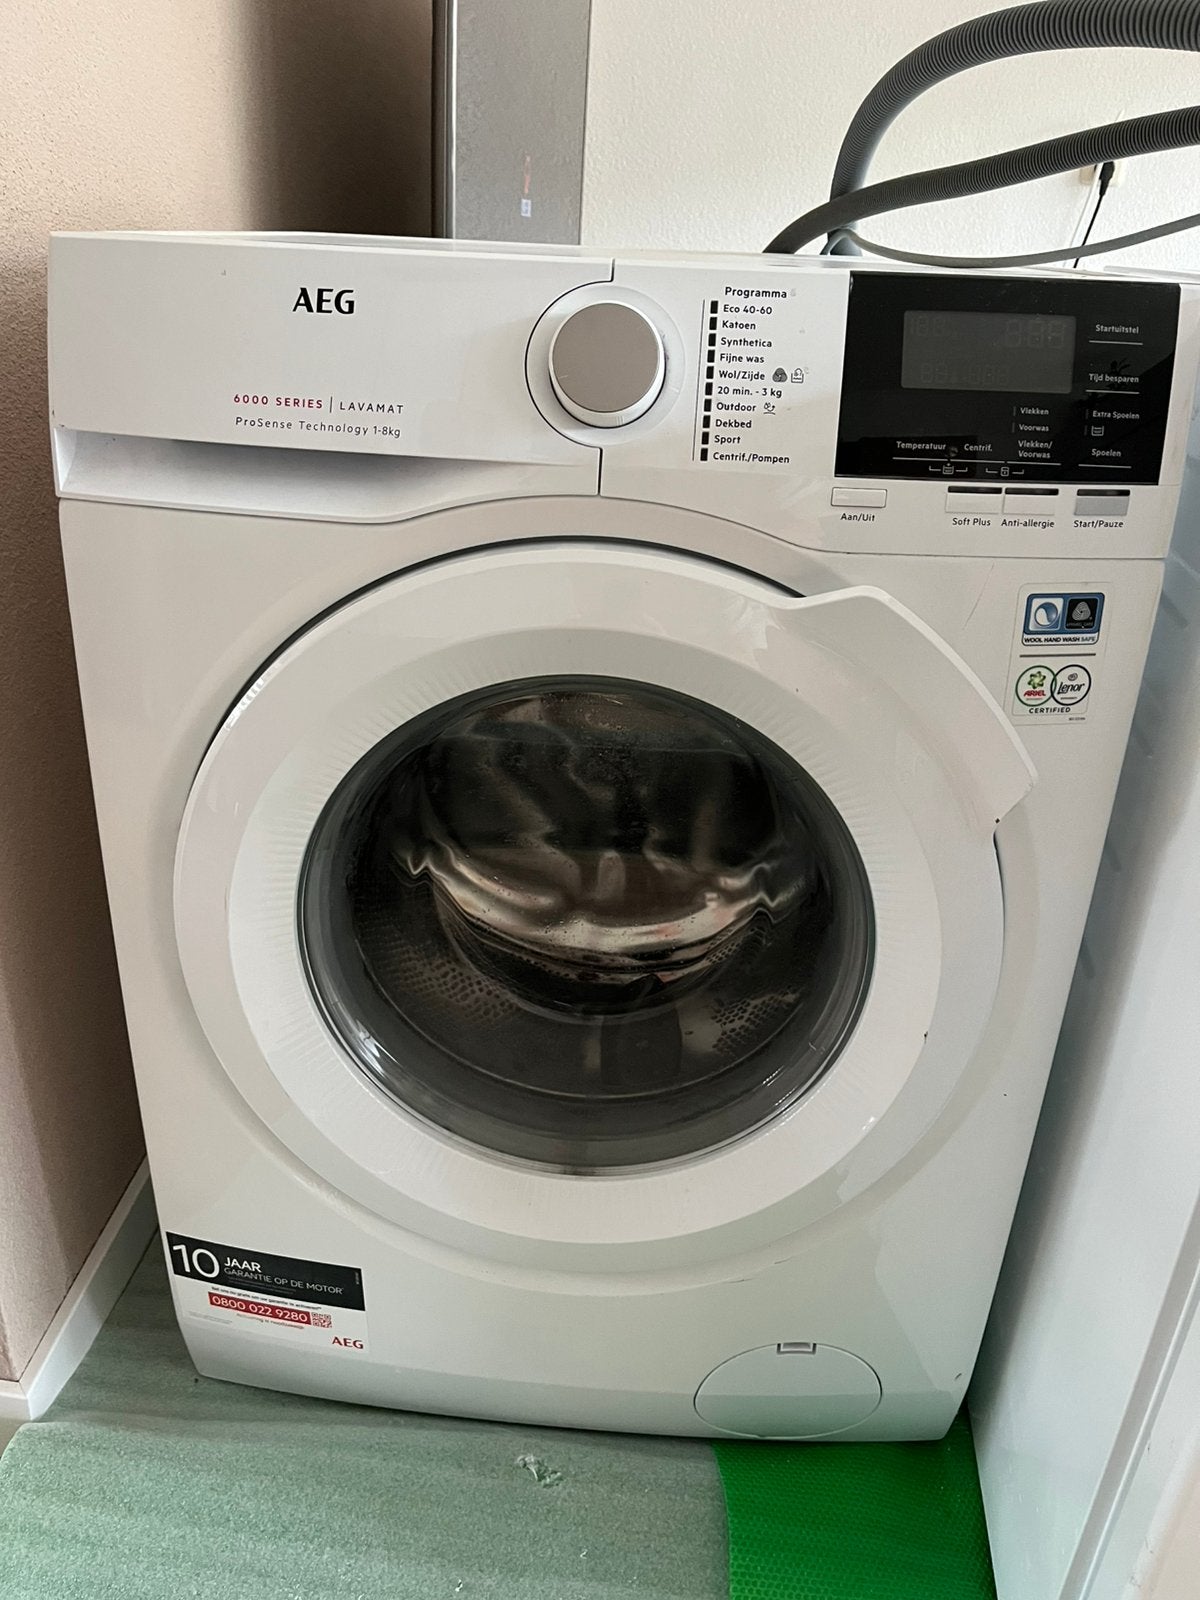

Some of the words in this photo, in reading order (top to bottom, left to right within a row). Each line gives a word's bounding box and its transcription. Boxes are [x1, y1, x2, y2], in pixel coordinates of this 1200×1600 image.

[725, 287, 787, 299] Programma
[293, 288, 355, 314] AEG
[723, 305, 740, 313] Eco
[743, 305, 772, 314] 40-60
[722, 321, 756, 330] Katoen
[1095, 324, 1139, 335] Startuitstel
[721, 337, 772, 348] Synthetica
[720, 354, 743, 363] Fijne
[719, 370, 765, 381] Wol/Zijde
[1089, 373, 1103, 383] Tijd
[1105, 374, 1139, 384] besparen
[717, 386, 730, 395] 20
[732, 387, 752, 396] min.
[762, 388, 768, 396] 3
[770, 388, 782, 398] kg
[233, 394, 268, 405] 6000
[276, 397, 323, 409] SERIES
[339, 401, 403, 414] LAVAMAT
[717, 402, 757, 412] Outdoor
[1020, 407, 1049, 415] Vlekken
[1093, 410, 1111, 419] Extra
[1112, 411, 1140, 420] Spoelen
[235, 417, 292, 428] ProSense
[299, 421, 368, 436] Technology
[373, 426, 401, 438] 1-8kg
[715, 419, 752, 428] Dekbed
[1019, 424, 1049, 432] Voorwas
[714, 435, 741, 445] Sport
[1018, 440, 1052, 450] Vlekken/
[896, 441, 946, 451] Temperatuur
[964, 443, 992, 452] Centrif.
[713, 452, 790, 464] Centrif./Pompen
[1018, 450, 1050, 459] Voorwas
[1091, 448, 1121, 458] Spoelen
[840, 512, 875, 522] Aan/Uit
[952, 517, 971, 526] Soft
[972, 518, 991, 526] Plus
[1001, 518, 1055, 529] Anti-allergie
[1073, 519, 1124, 529] Start/Pauze
[1058, 682, 1085, 695] Lenor
[172, 1244, 220, 1279] 10
[224, 1257, 262, 1273] JAAR
[224, 1267, 272, 1283] GARANTIE
[274, 1277, 288, 1286] OP
[291, 1279, 304, 1288] DE
[212, 1296, 246, 1311] 0800
[249, 1305, 273, 1317] 022
[276, 1309, 308, 1322] 9280
[332, 1336, 364, 1350] AEG
